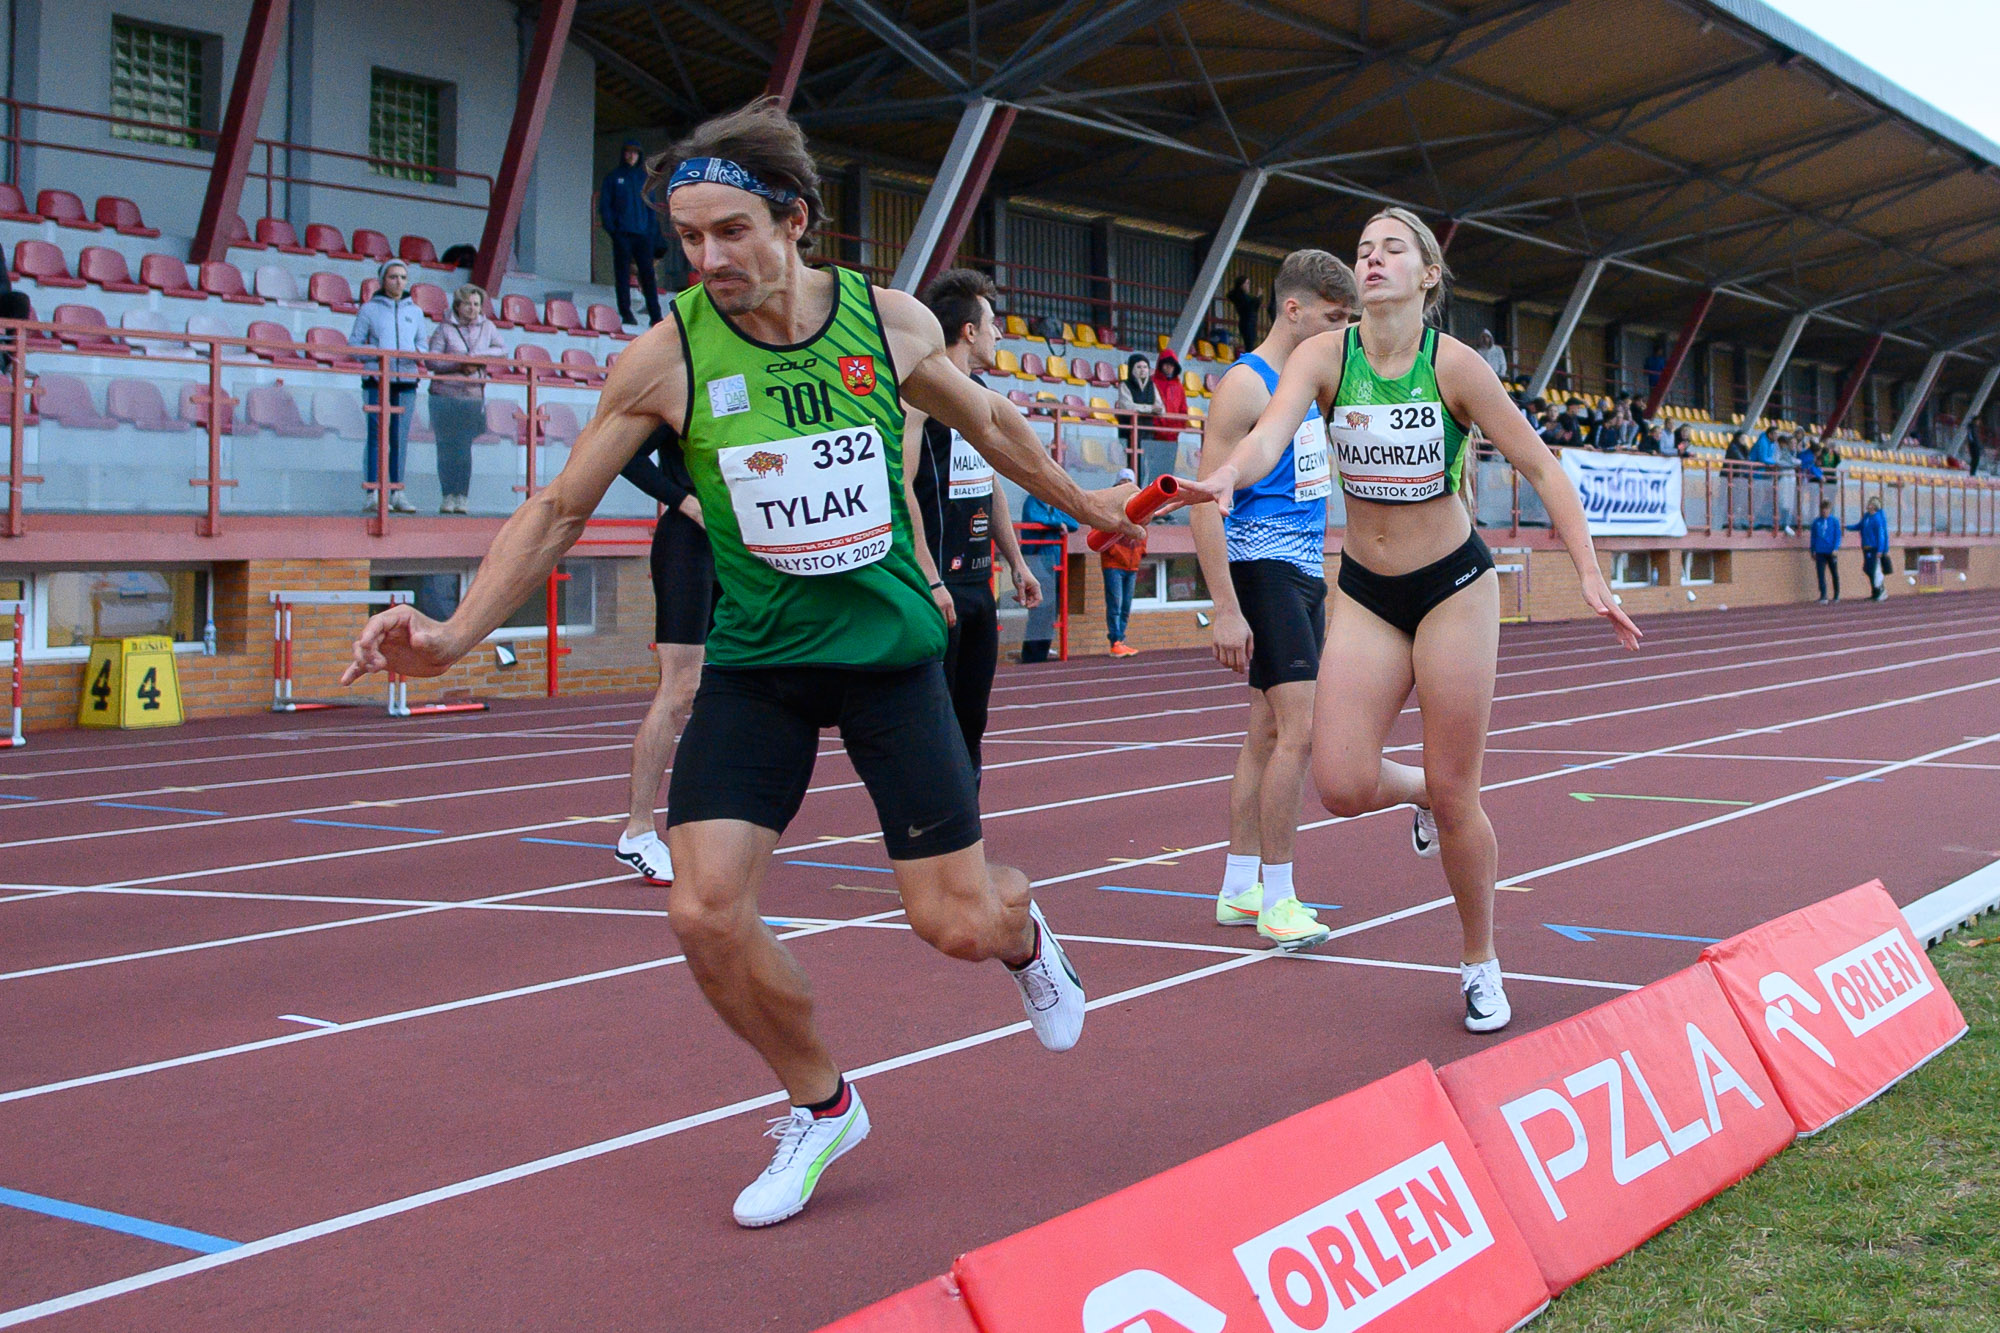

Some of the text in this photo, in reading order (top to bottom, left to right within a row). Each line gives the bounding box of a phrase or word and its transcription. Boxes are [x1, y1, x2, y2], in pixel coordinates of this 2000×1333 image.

[766, 358, 818, 373] COLO
[1389, 406, 1436, 430] 328
[811, 432, 875, 469] 332
[1337, 441, 1441, 465] MAJCHRZAK
[756, 484, 868, 529] TYLAK
[1411, 482, 1439, 497] 2022
[853, 540, 886, 563] 2022
[91, 659, 112, 710] 4
[137, 667, 161, 710] 4
[1831, 941, 1922, 1020] ORLEN
[1499, 1022, 1765, 1222] PZLA
[1268, 1166, 1473, 1331] ORLEN
